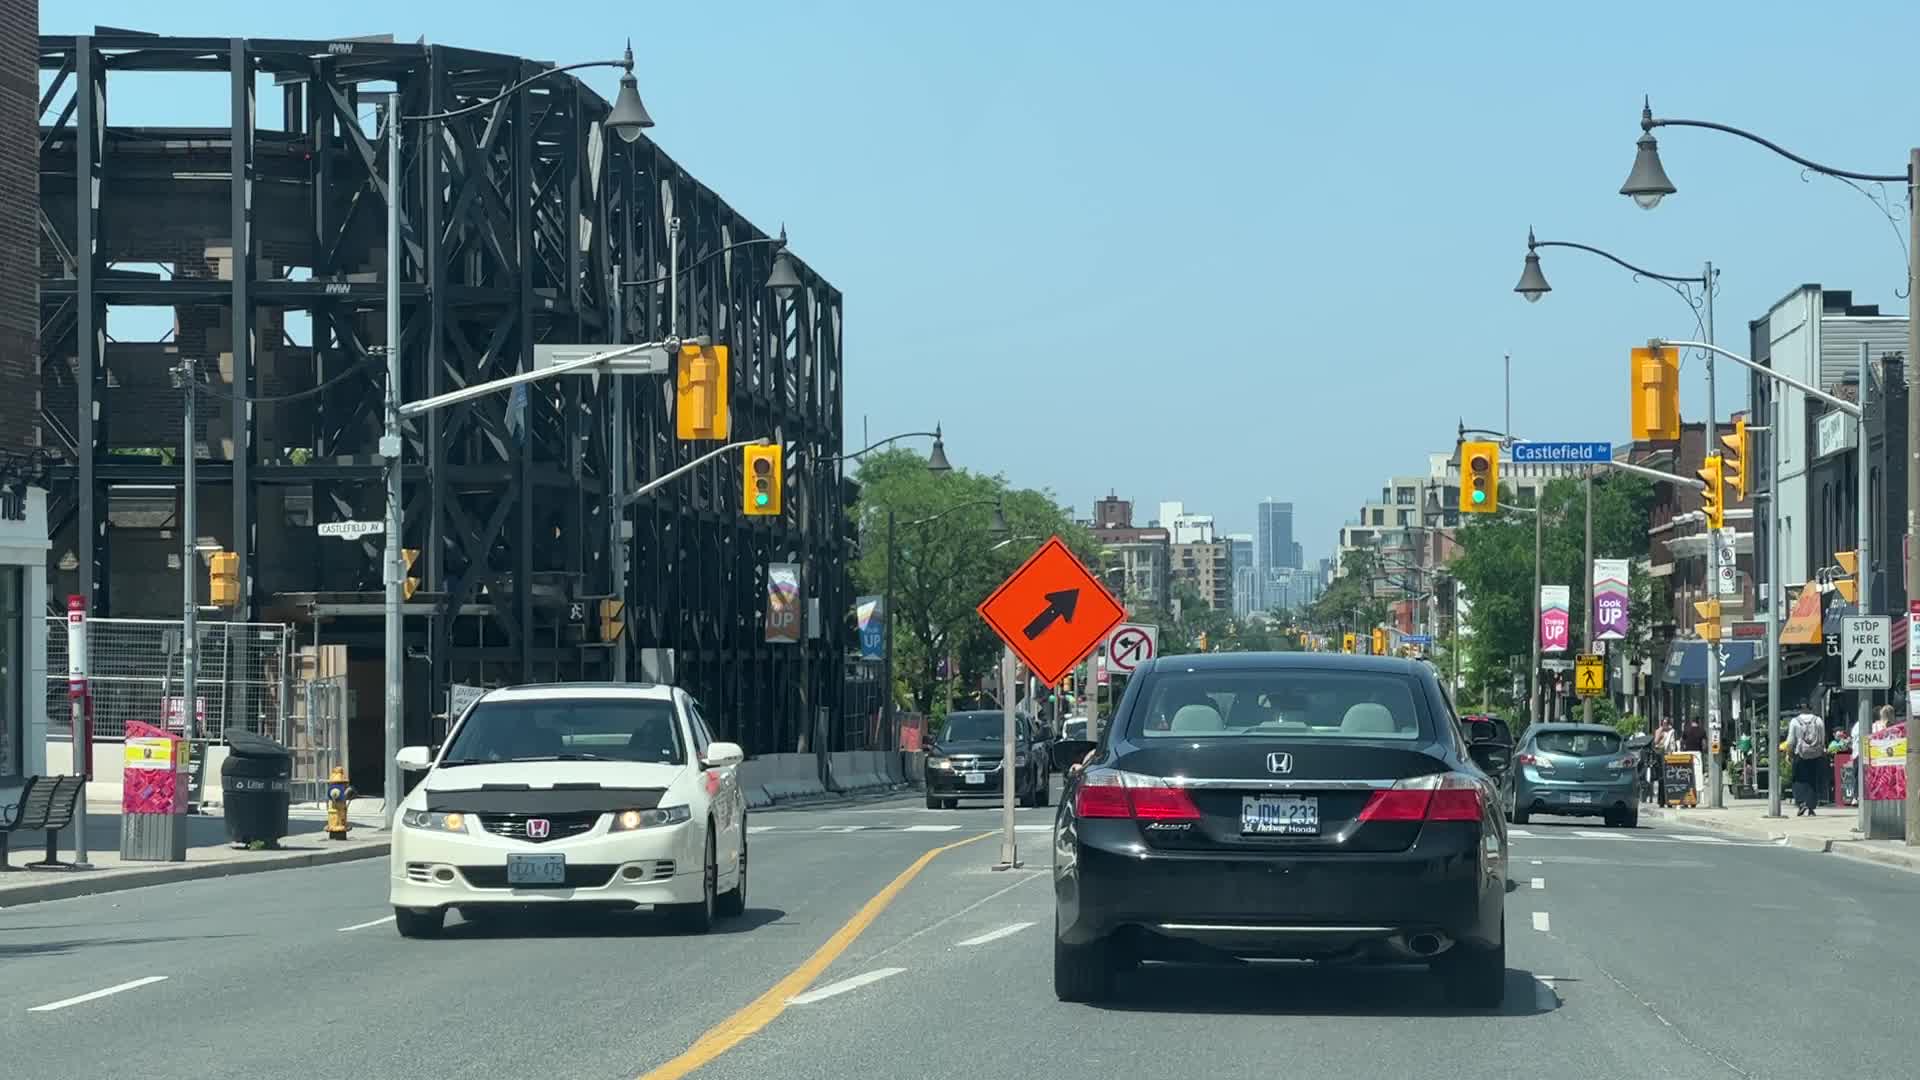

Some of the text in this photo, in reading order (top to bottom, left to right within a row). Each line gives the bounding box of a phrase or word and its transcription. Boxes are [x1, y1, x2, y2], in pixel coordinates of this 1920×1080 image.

[1516, 445, 1593, 460] Castlefield
[321, 523, 367, 533] CASTLEFIELD
[1599, 599, 1622, 608] Look
[771, 611, 794, 628] UP
[1599, 607, 1622, 625] UP
[1853, 621, 1880, 632] STOP
[1545, 625, 1565, 640] UP
[864, 633, 881, 648] UP
[1852, 634, 1880, 644] HERE
[1871, 647, 1886, 657] ON
[1865, 660, 1886, 670] RED
[1848, 673, 1884, 683] SIGNAL
[1289, 804, 1317, 824] 233
[1145, 822, 1191, 831] Accord
[1288, 825, 1316, 833] Honda
